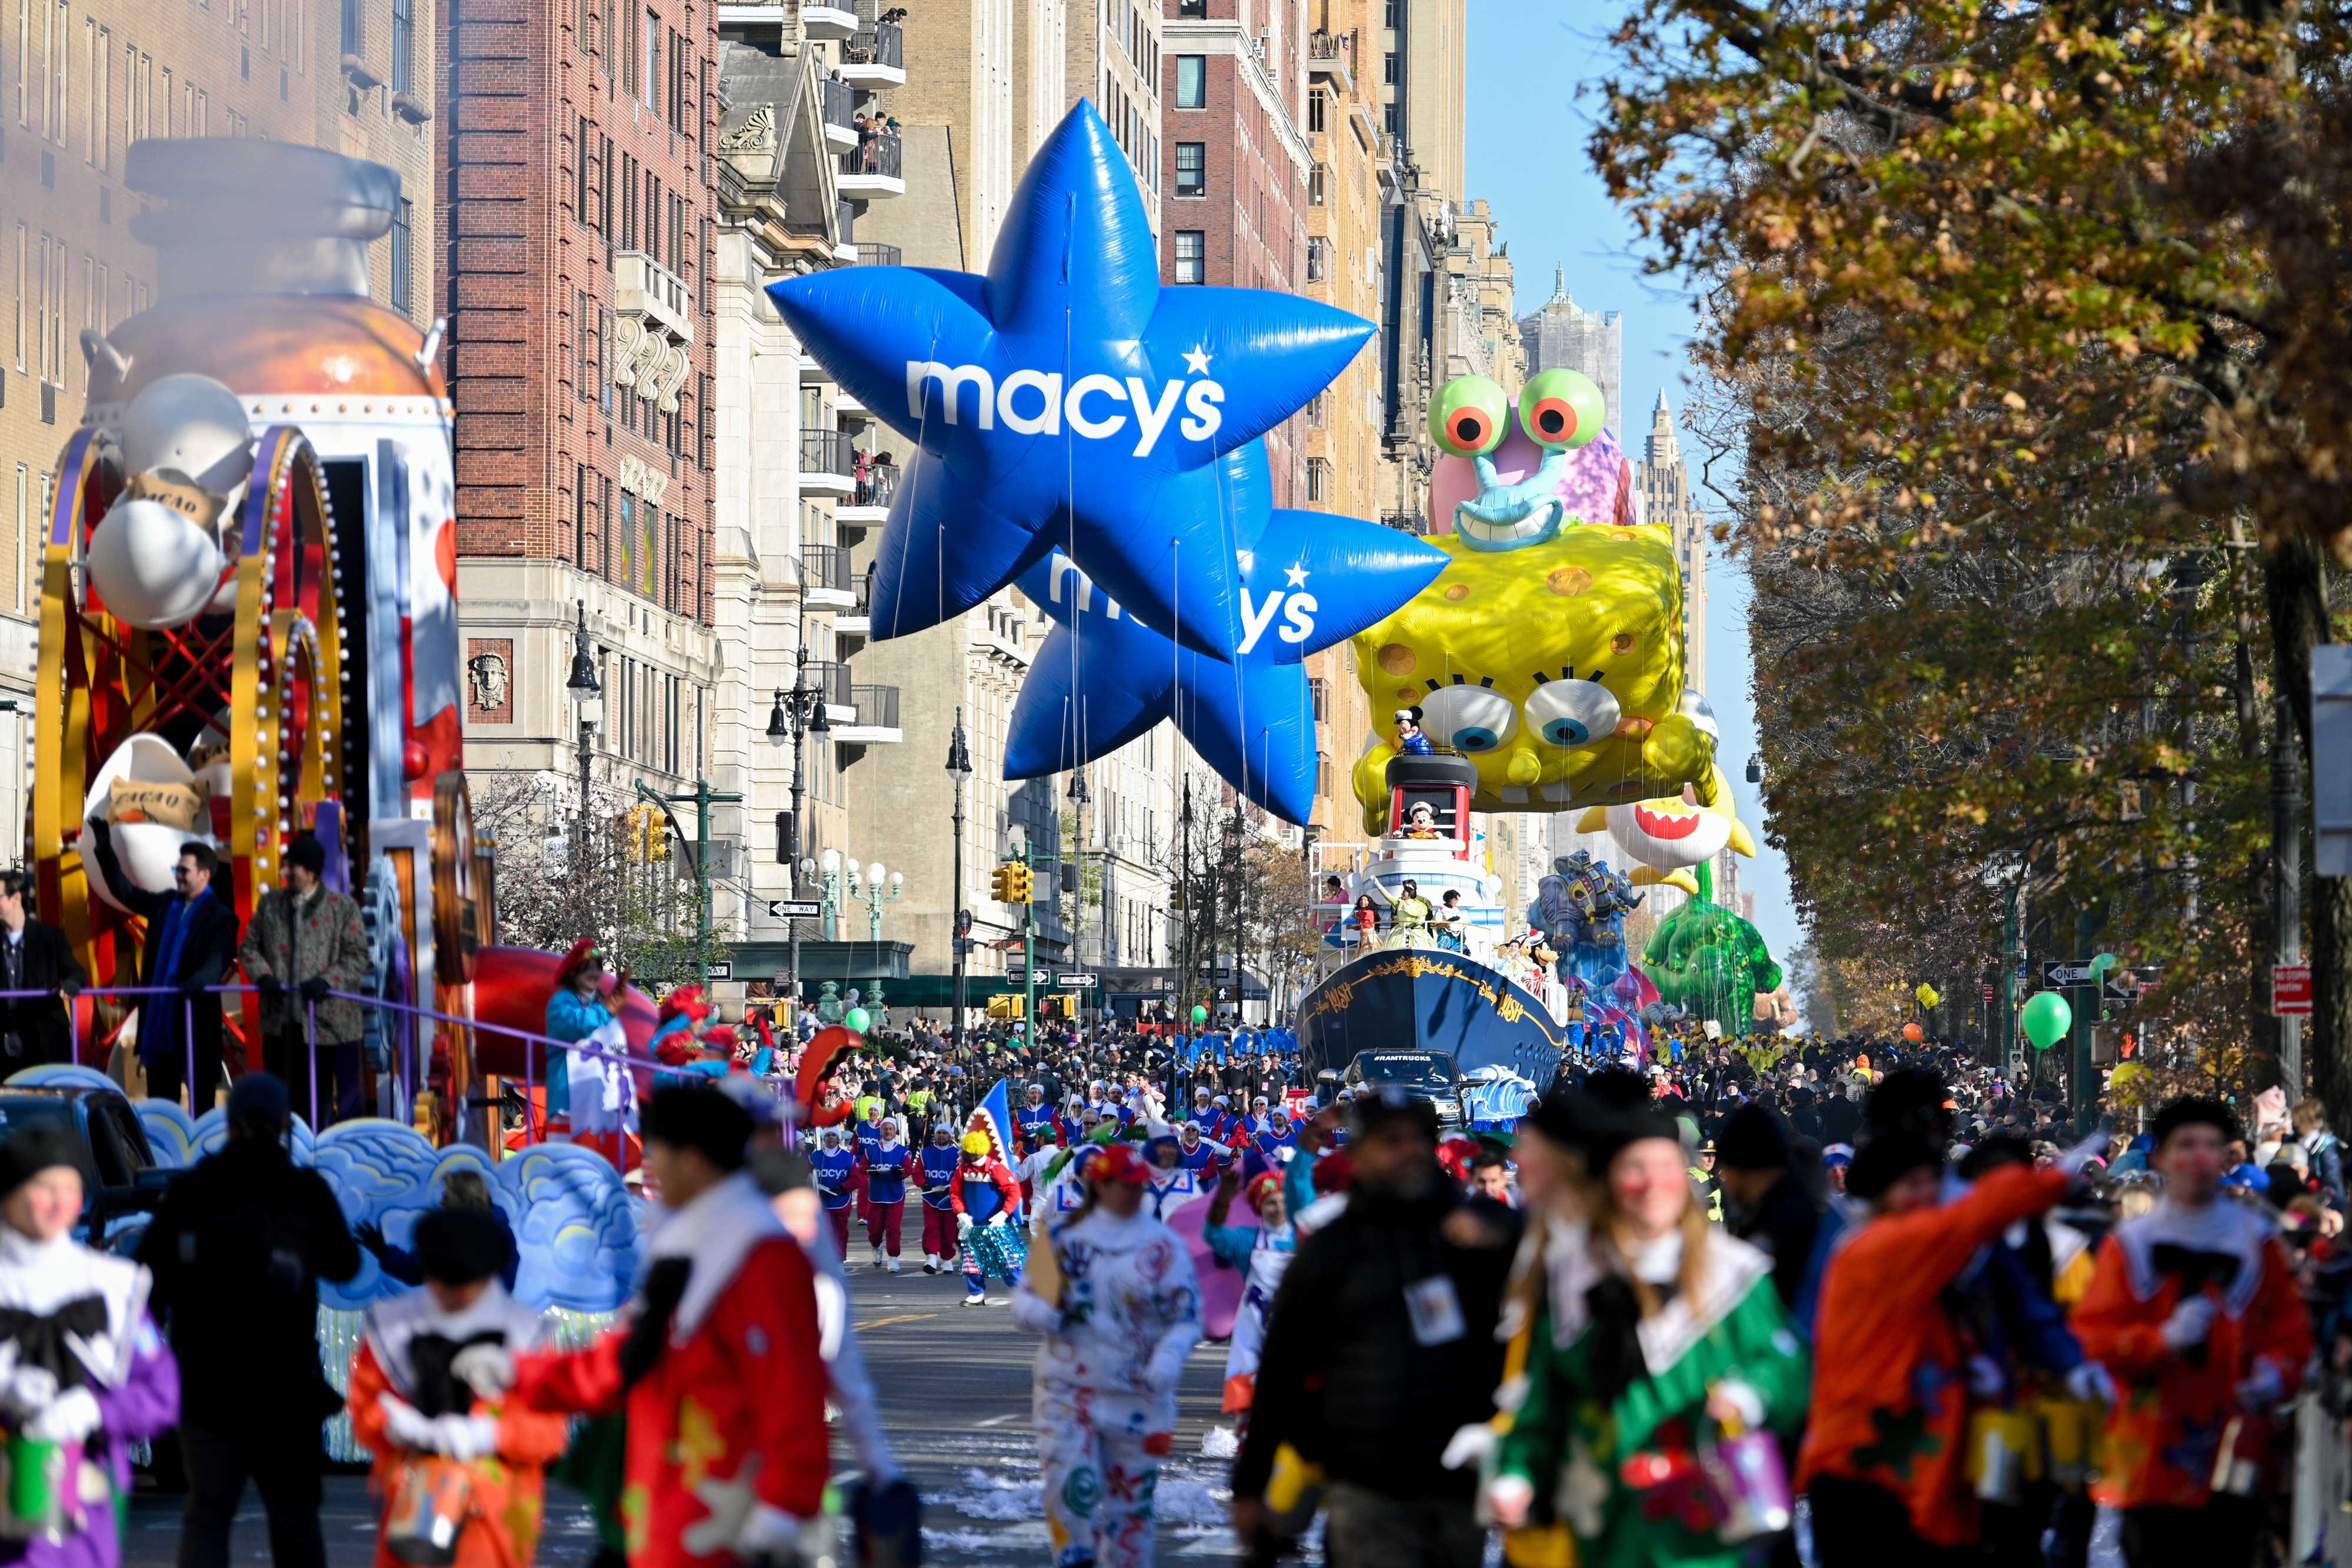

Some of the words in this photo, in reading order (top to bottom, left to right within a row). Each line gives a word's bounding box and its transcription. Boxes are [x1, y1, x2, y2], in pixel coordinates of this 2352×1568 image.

[116, 792, 179, 807] CACAO
[1986, 855, 2022, 865] PASSENG
[1986, 870, 2006, 879] CARS
[998, 941, 1006, 949] 68
[1010, 941, 1017, 949] ST
[2056, 969, 2078, 979] ONE
[1324, 981, 1354, 1014] WISH
[1497, 987, 1524, 1023] WISH
